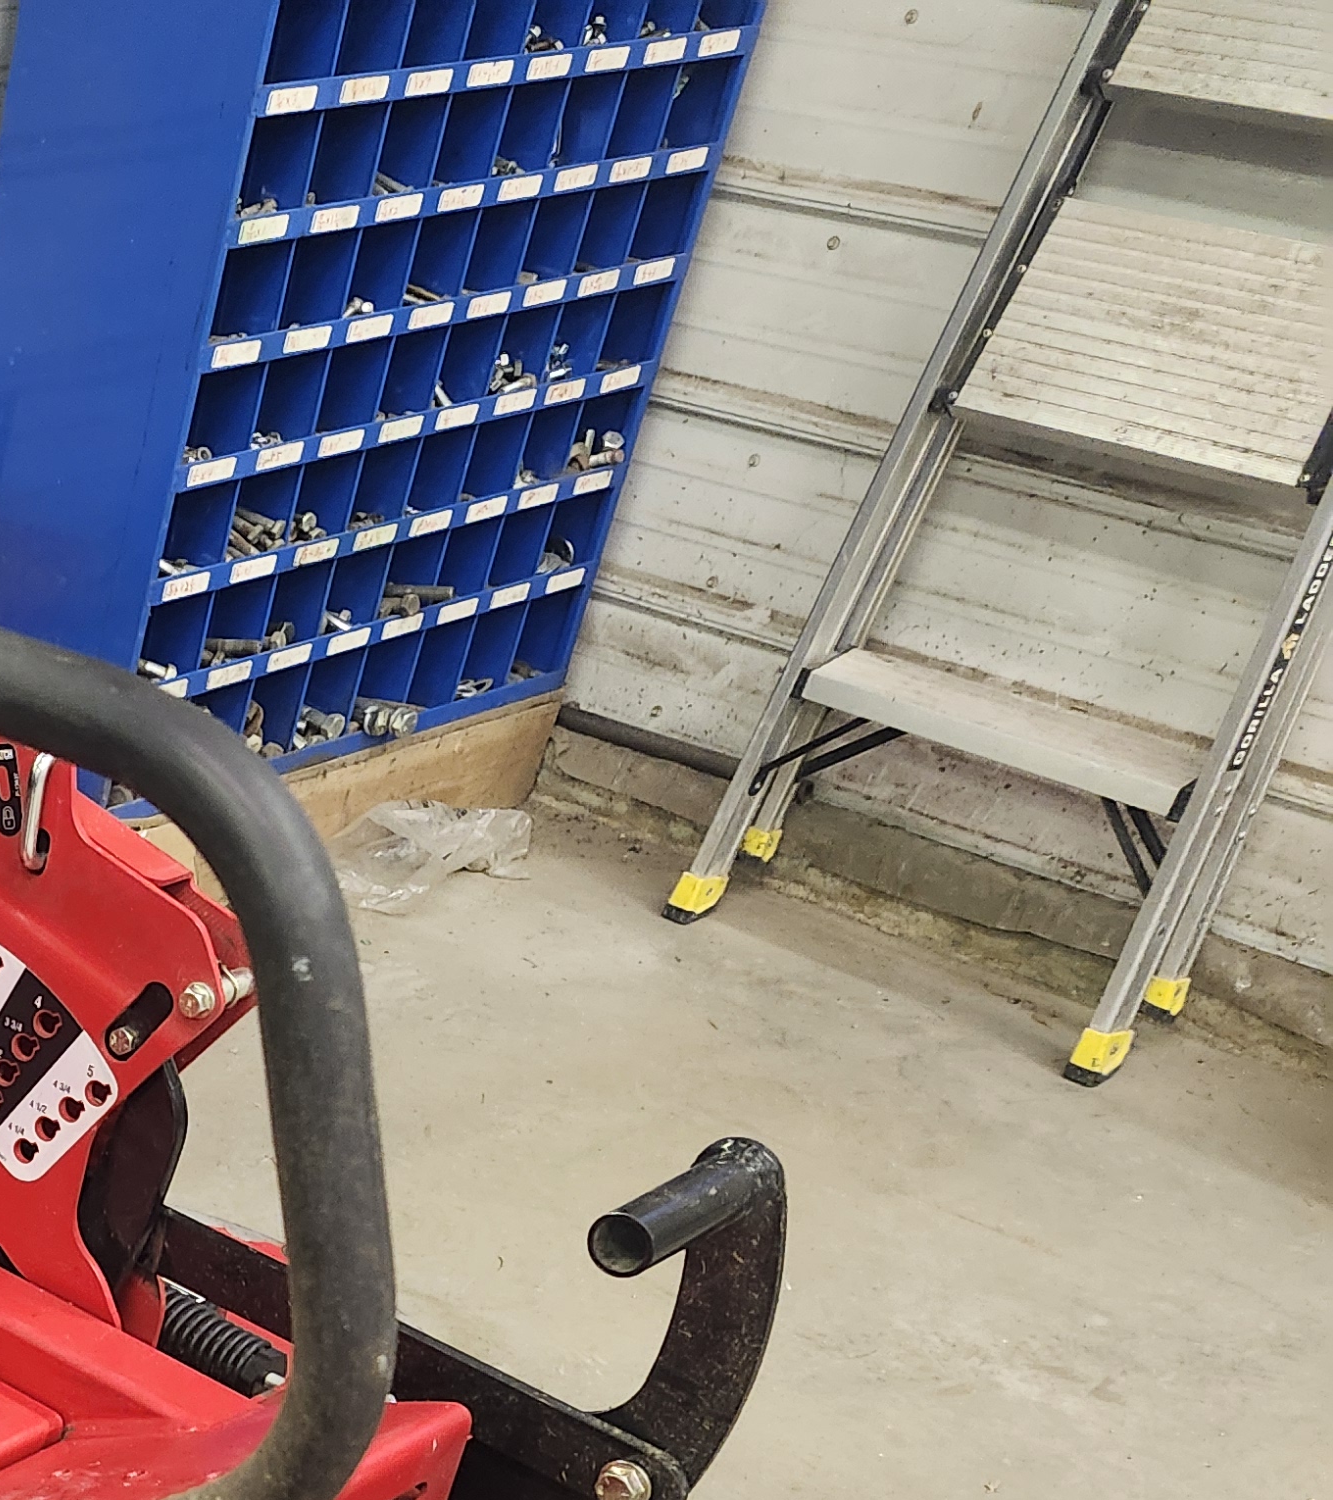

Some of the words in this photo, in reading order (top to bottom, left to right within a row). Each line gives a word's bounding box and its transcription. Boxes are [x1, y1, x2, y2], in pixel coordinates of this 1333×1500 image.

[1295, 530, 1333, 624] LADDE
[34, 996, 43, 1008] 4
[87, 1065, 95, 1077] 5
